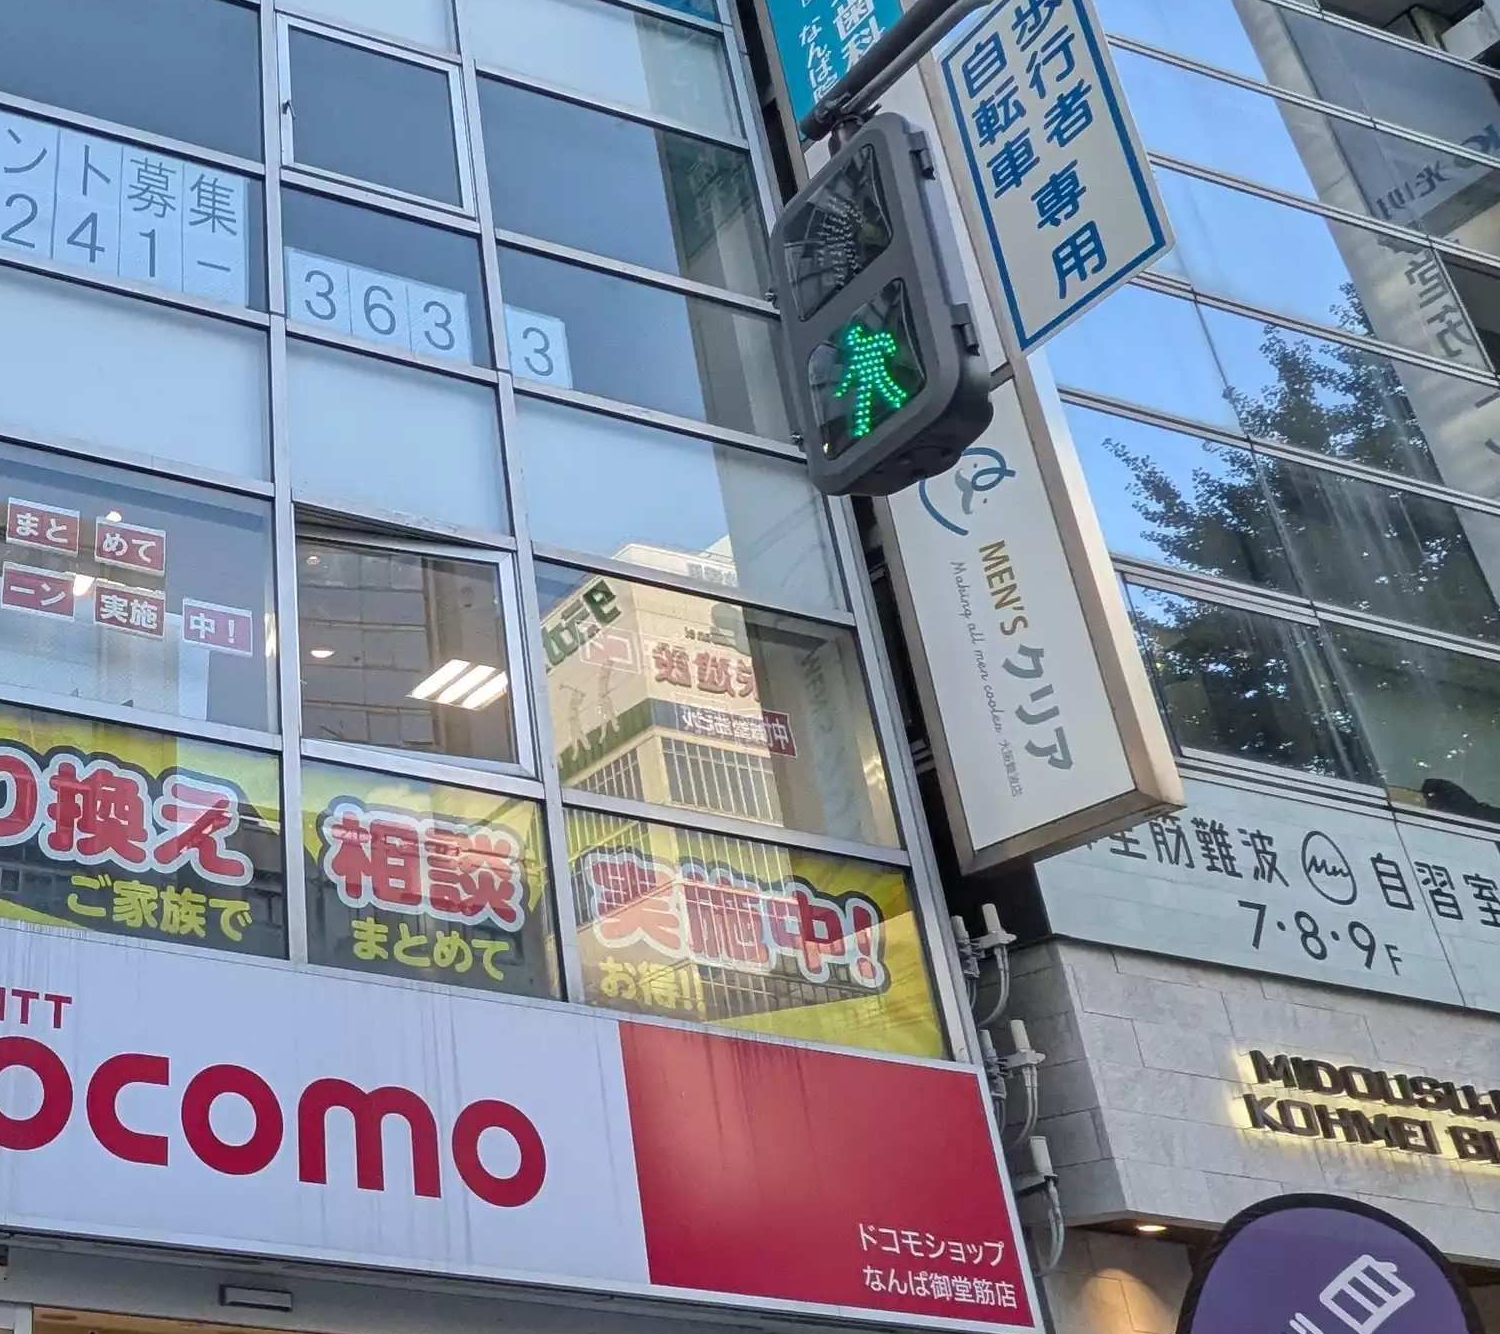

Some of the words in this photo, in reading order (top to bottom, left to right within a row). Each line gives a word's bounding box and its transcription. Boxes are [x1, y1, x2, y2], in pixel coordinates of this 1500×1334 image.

[961, 36, 1040, 200] 自転車
[1030, 159, 1109, 301] 専用
[977, 539, 1030, 637] MEN'S
[1002, 642, 1074, 771] クリア
[324, 809, 520, 929] 相談
[66, 874, 253, 942] ご家族で
[350, 918, 511, 981] まとめて
[1244, 1093, 1444, 1156] KOHMEI
[858, 1222, 1005, 1267] ドコモショップ
[862, 1265, 1018, 1310] なんば御堂筋店
